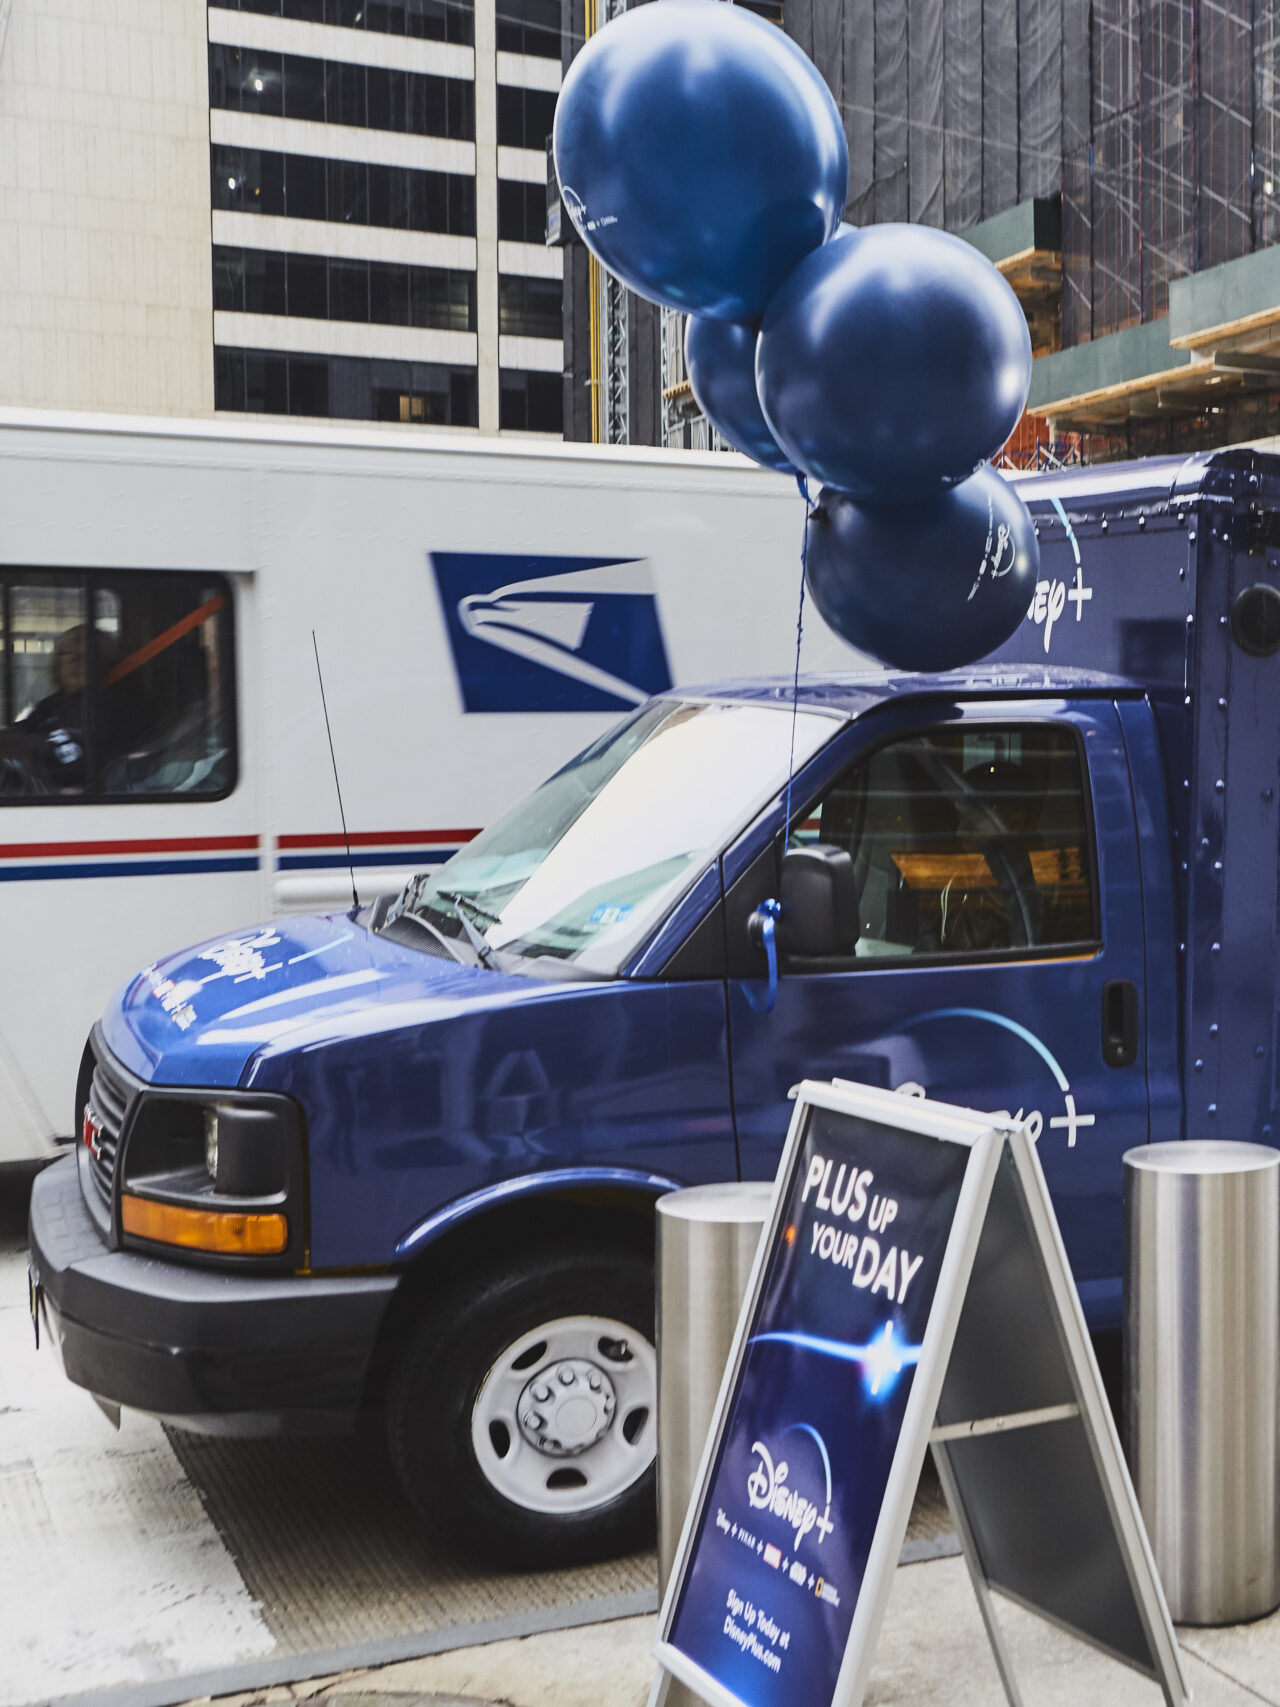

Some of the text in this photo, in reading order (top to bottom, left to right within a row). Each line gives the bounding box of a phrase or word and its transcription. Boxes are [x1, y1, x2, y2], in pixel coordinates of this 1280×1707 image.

[801, 1155, 898, 1234] PLUS UP
[811, 1221, 924, 1304] YOUR DAY
[726, 1589, 790, 1650] Sign Up Today at
